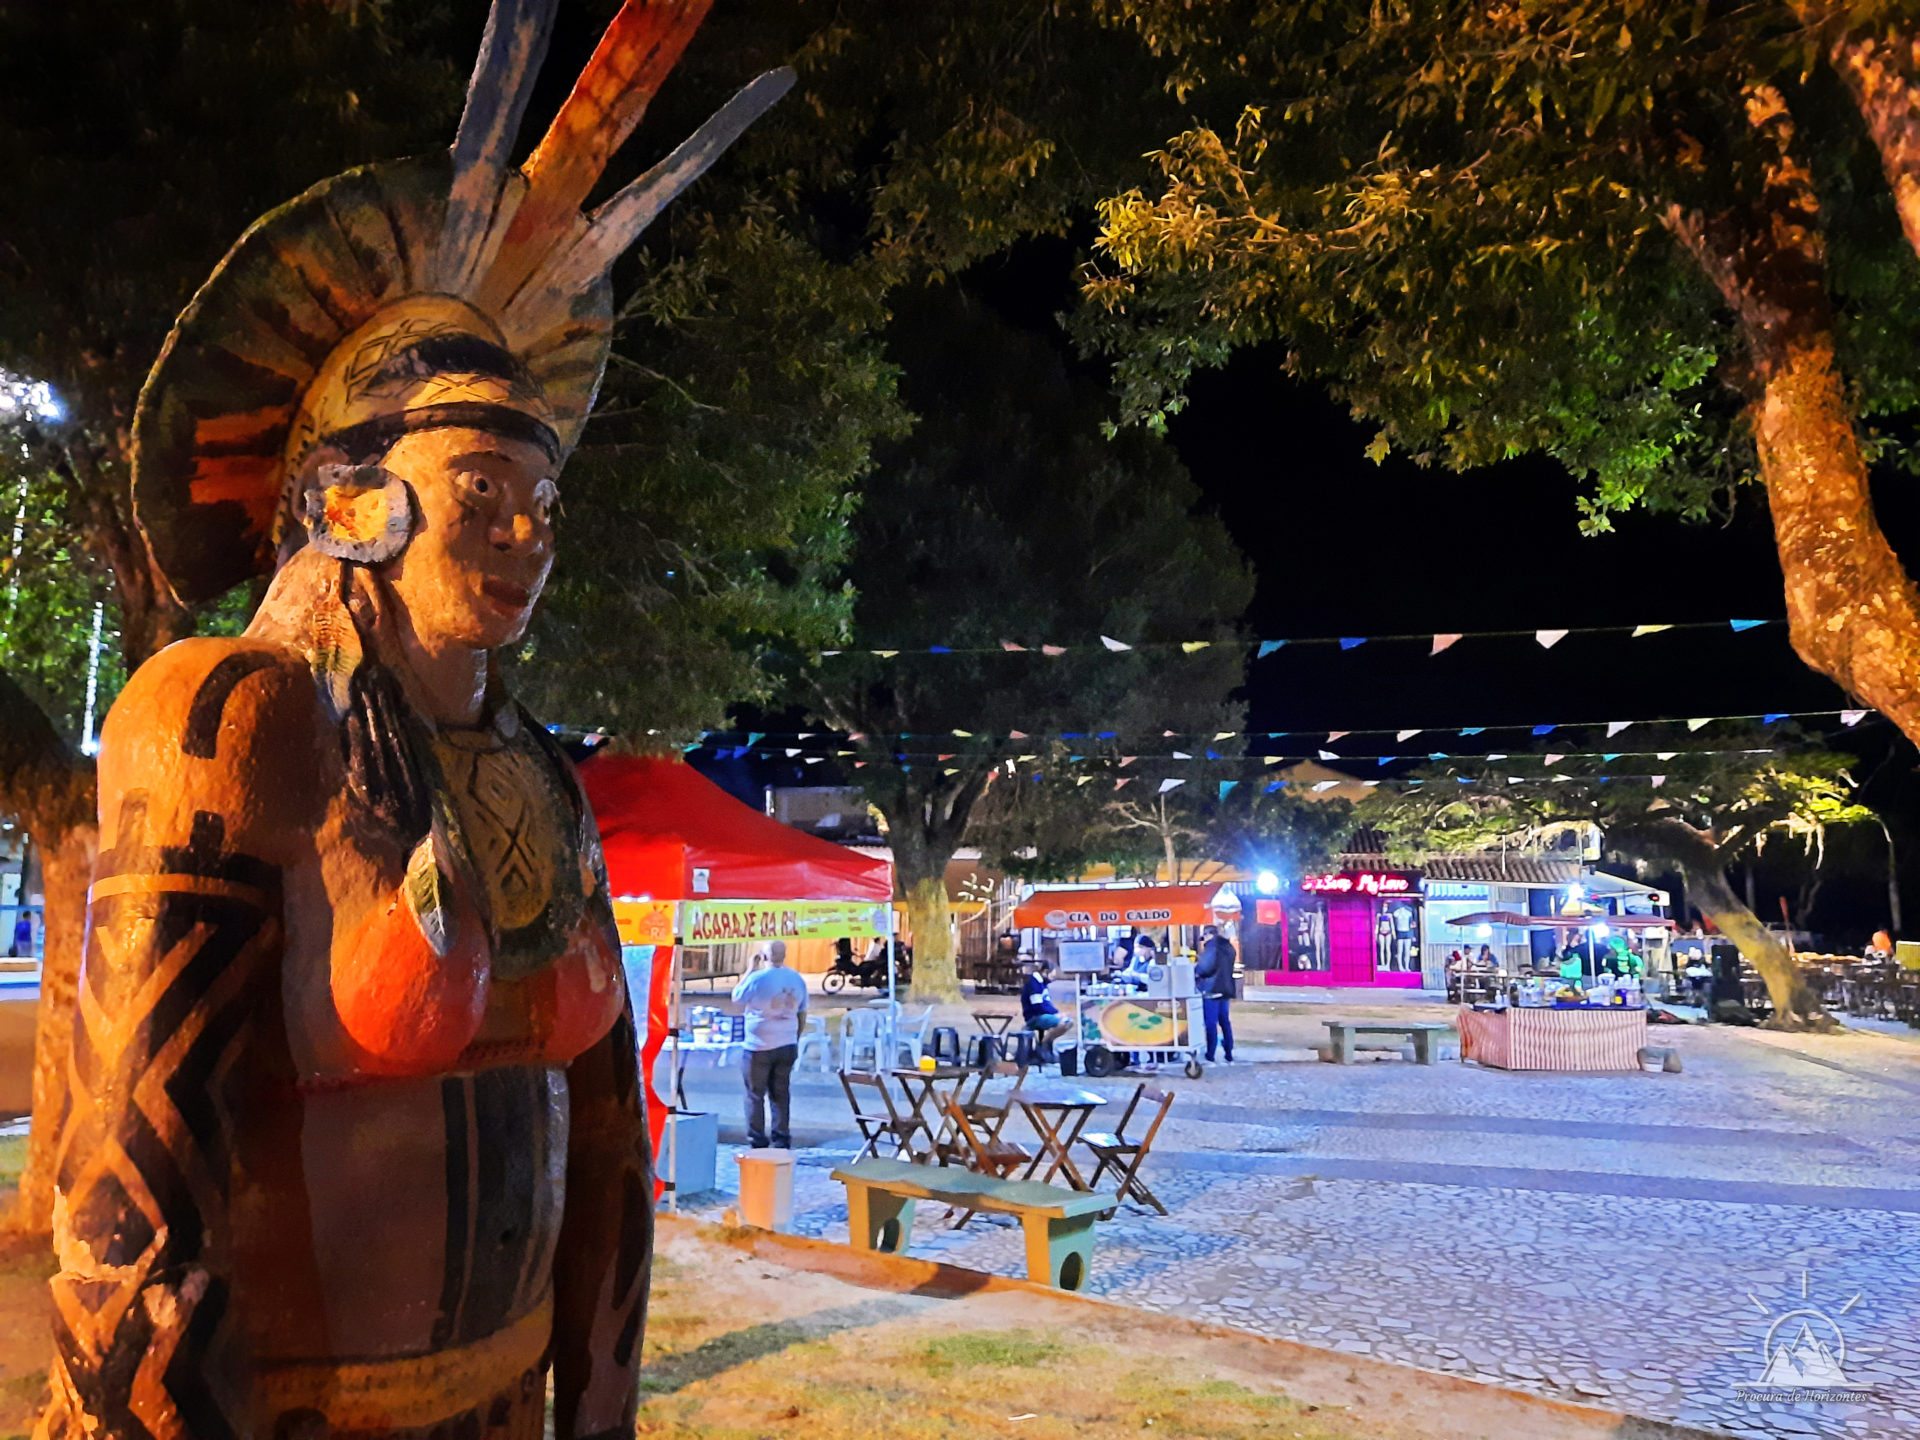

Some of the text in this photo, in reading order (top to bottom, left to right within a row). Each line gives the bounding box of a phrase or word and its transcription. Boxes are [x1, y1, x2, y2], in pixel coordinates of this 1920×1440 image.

[693, 905, 757, 940] ACARAJÉ
[760, 911, 777, 937] DA
[1068, 910, 1171, 923] CIA DO CALDO
